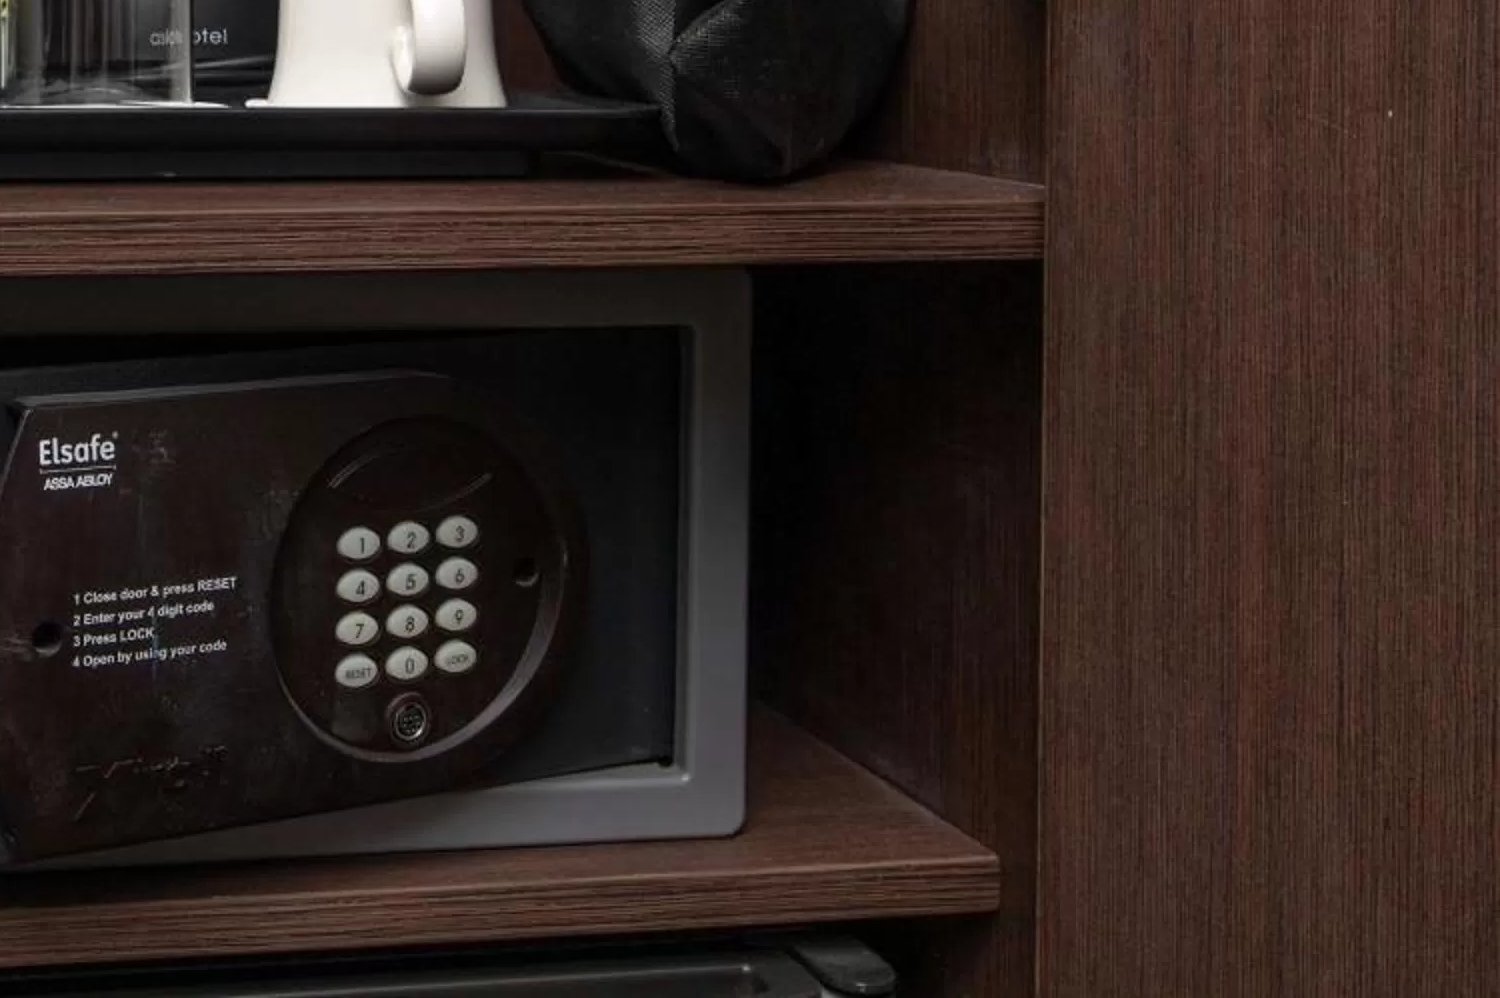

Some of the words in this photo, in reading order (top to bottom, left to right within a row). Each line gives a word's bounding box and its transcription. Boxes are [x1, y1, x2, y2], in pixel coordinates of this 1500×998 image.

[39, 433, 116, 466] Elsafe
[44, 476, 74, 490] ASSA
[76, 473, 113, 488] ABLOY
[73, 594, 80, 605] 1
[83, 590, 117, 604] Close
[120, 588, 148, 600] door
[150, 586, 159, 597] &
[163, 583, 194, 598] press
[197, 577, 237, 591] RESET
[73, 615, 80, 626] 2
[83, 612, 115, 625] Enter
[118, 609, 145, 624] your
[148, 606, 154, 617] 4
[157, 604, 183, 618] digit
[186, 600, 215, 612] code
[73, 636, 80, 647] 3
[83, 632, 117, 646] Press
[120, 627, 155, 641] LOCK
[72, 656, 80, 667] 4
[83, 652, 115, 669] Open
[117, 650, 132, 664] by
[135, 647, 167, 661] using
[170, 644, 196, 658] your
[200, 639, 227, 652] code
